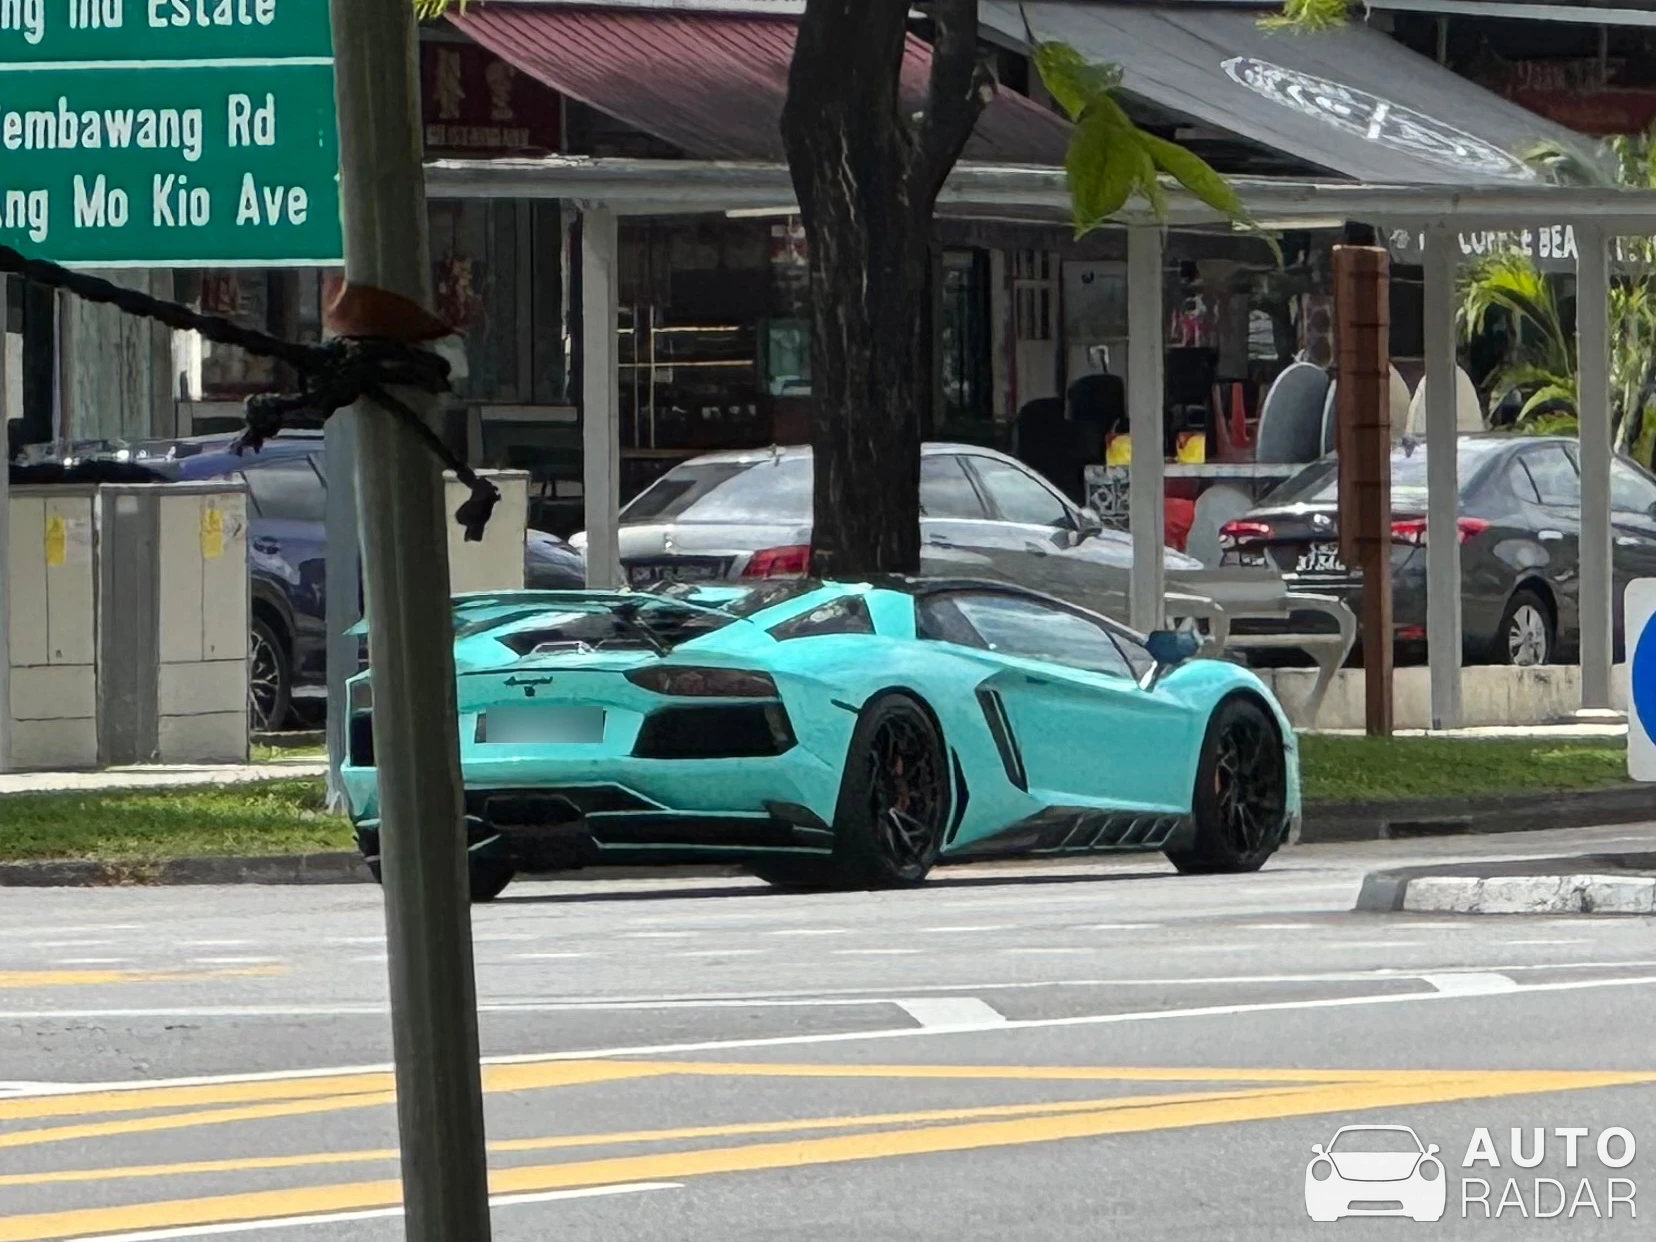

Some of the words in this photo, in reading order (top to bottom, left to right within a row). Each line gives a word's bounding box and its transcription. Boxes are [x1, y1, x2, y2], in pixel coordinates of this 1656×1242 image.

[0, 96, 202, 162] embawang
[227, 92, 276, 147] Rd
[0, 189, 49, 243] ng
[73, 174, 129, 228] Mo
[153, 173, 211, 227] Kio
[235, 172, 308, 226] Ave
